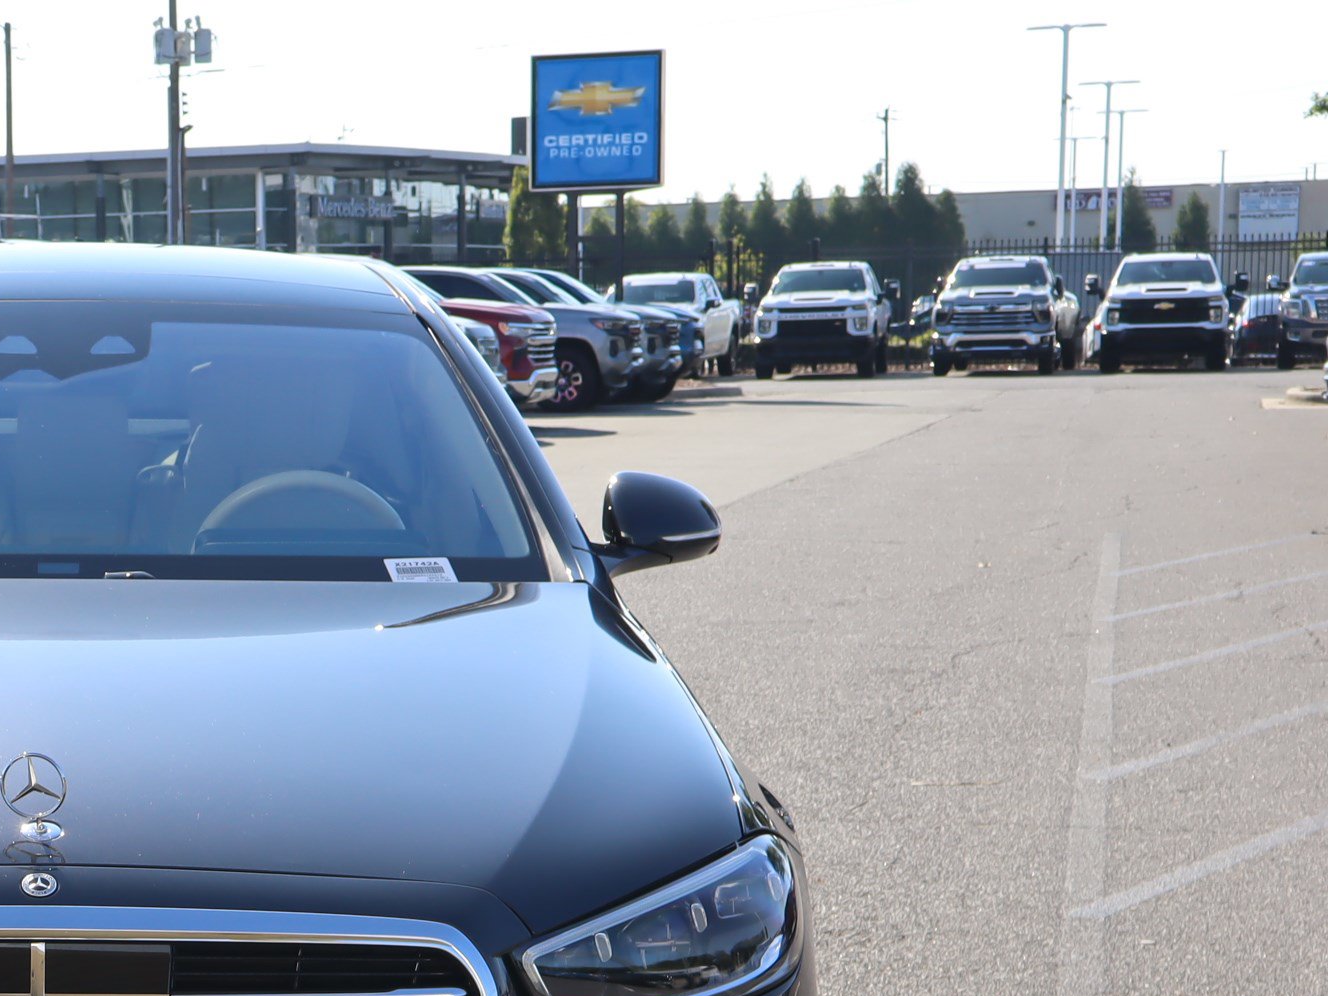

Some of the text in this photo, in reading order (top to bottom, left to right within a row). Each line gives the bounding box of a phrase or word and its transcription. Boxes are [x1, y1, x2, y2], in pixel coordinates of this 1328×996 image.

[544, 132, 648, 147] CERTIFIED
[549, 145, 642, 159] PRE-OWNED
[317, 196, 393, 218] Mercedes-Benz
